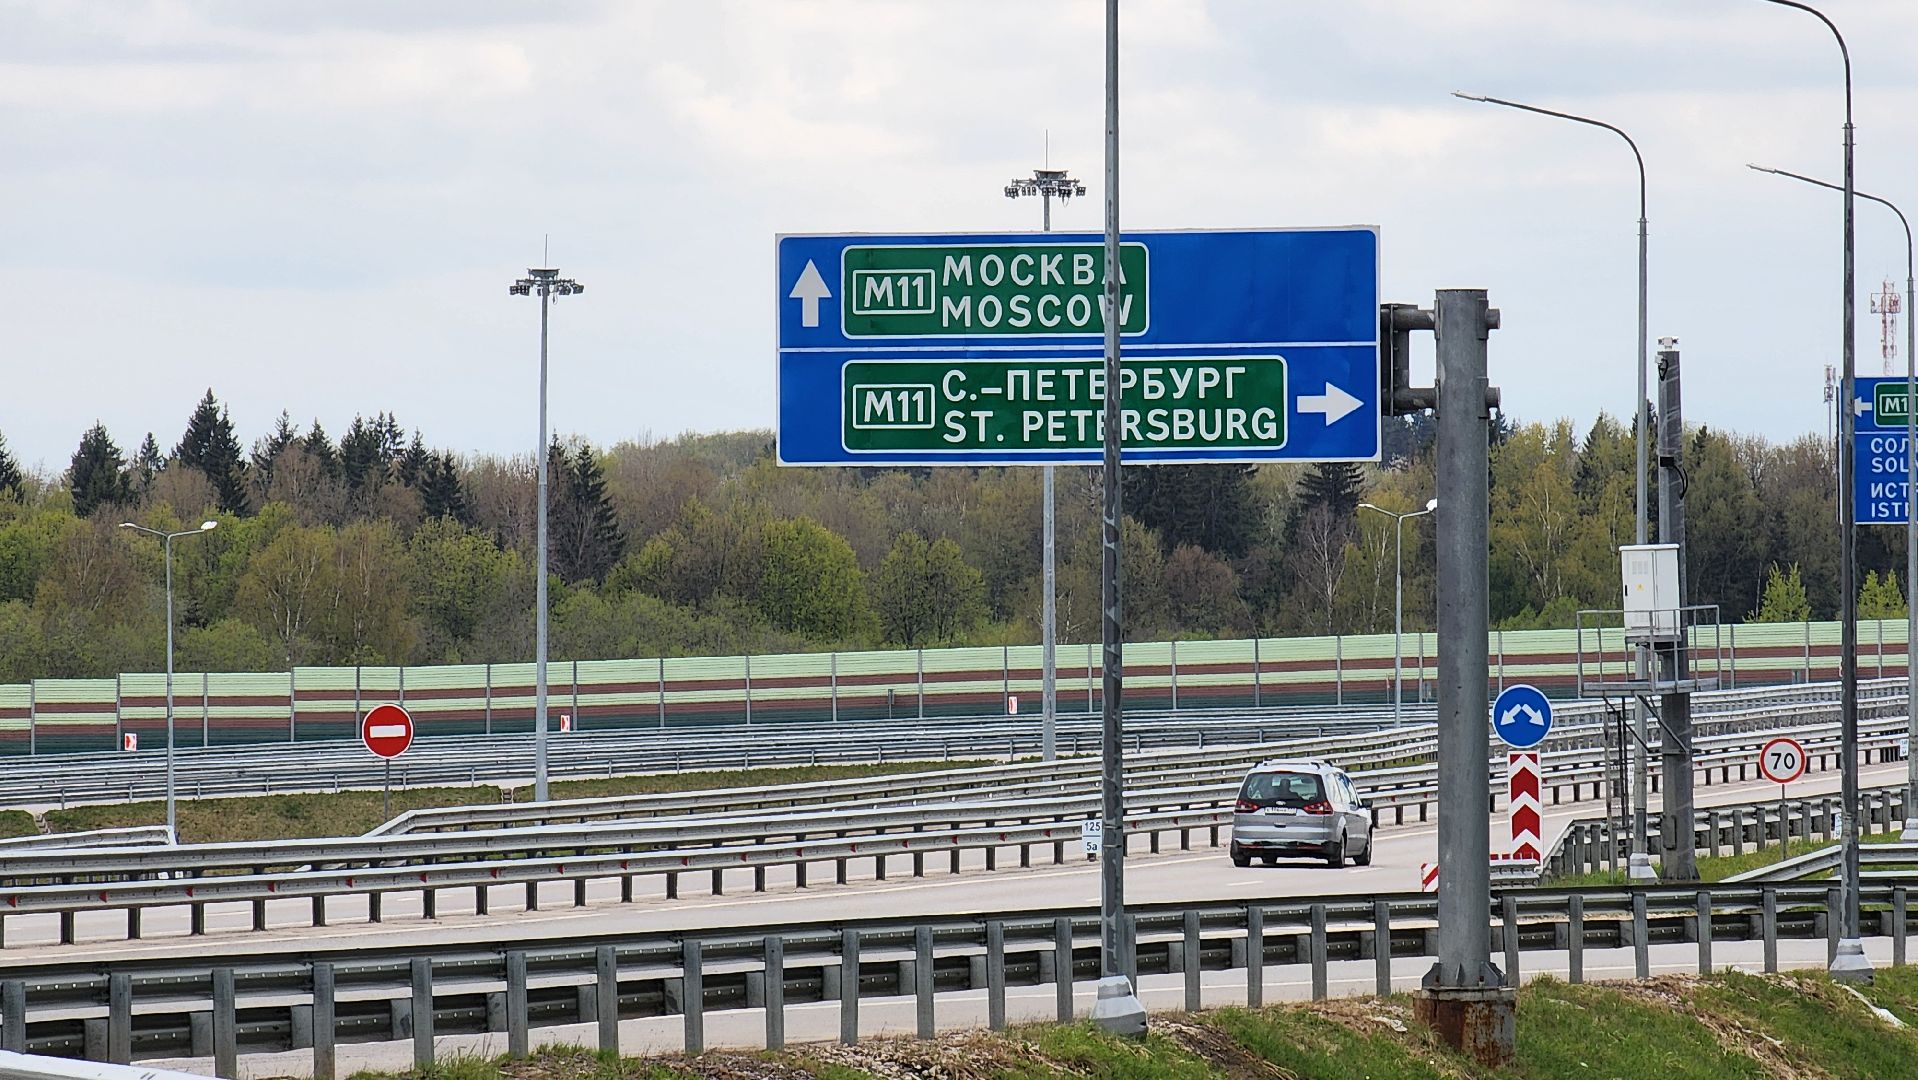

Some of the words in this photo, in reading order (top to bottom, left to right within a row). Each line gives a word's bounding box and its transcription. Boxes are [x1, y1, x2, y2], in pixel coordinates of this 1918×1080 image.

[864, 276, 924, 308] M11
[864, 391, 924, 422] M11
[943, 410, 1004, 443] ST.
[1771, 752, 1795, 770] 70
[1085, 821, 1101, 832] 125
